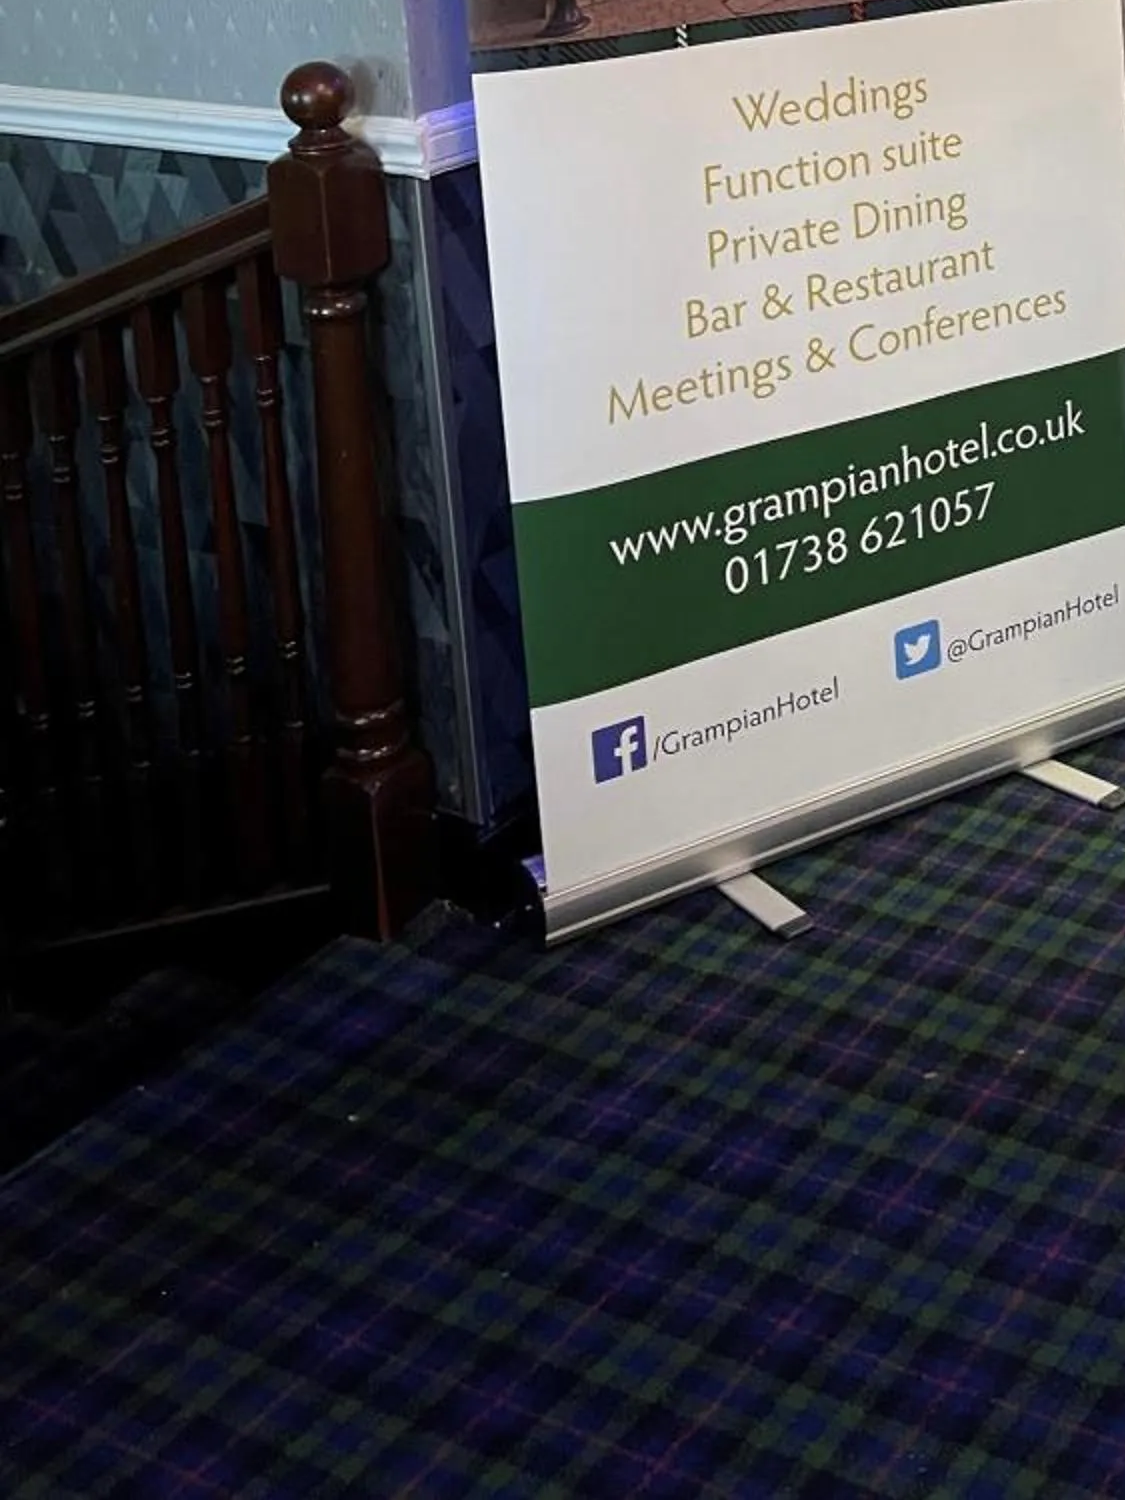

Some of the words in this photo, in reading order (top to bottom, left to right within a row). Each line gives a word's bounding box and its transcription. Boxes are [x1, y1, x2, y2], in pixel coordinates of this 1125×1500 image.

[732, 75, 929, 133] Weddings
[703, 149, 871, 205] Function
[882, 131, 963, 172] suite
[707, 217, 841, 269] Private
[853, 190, 969, 239] Dining
[686, 297, 748, 339] Bar
[762, 284, 794, 320] &
[806, 240, 996, 312] Restaurant
[607, 352, 792, 426] Meetings
[805, 338, 836, 373] &
[848, 288, 1068, 364] Conferences
[609, 400, 1086, 567] www.grampianhotel.co.uk
[723, 526, 849, 595] 01738
[858, 481, 999, 556] 621057
[945, 584, 1120, 664] @GrampianHotel
[653, 675, 840, 761] /GrampianHotel
